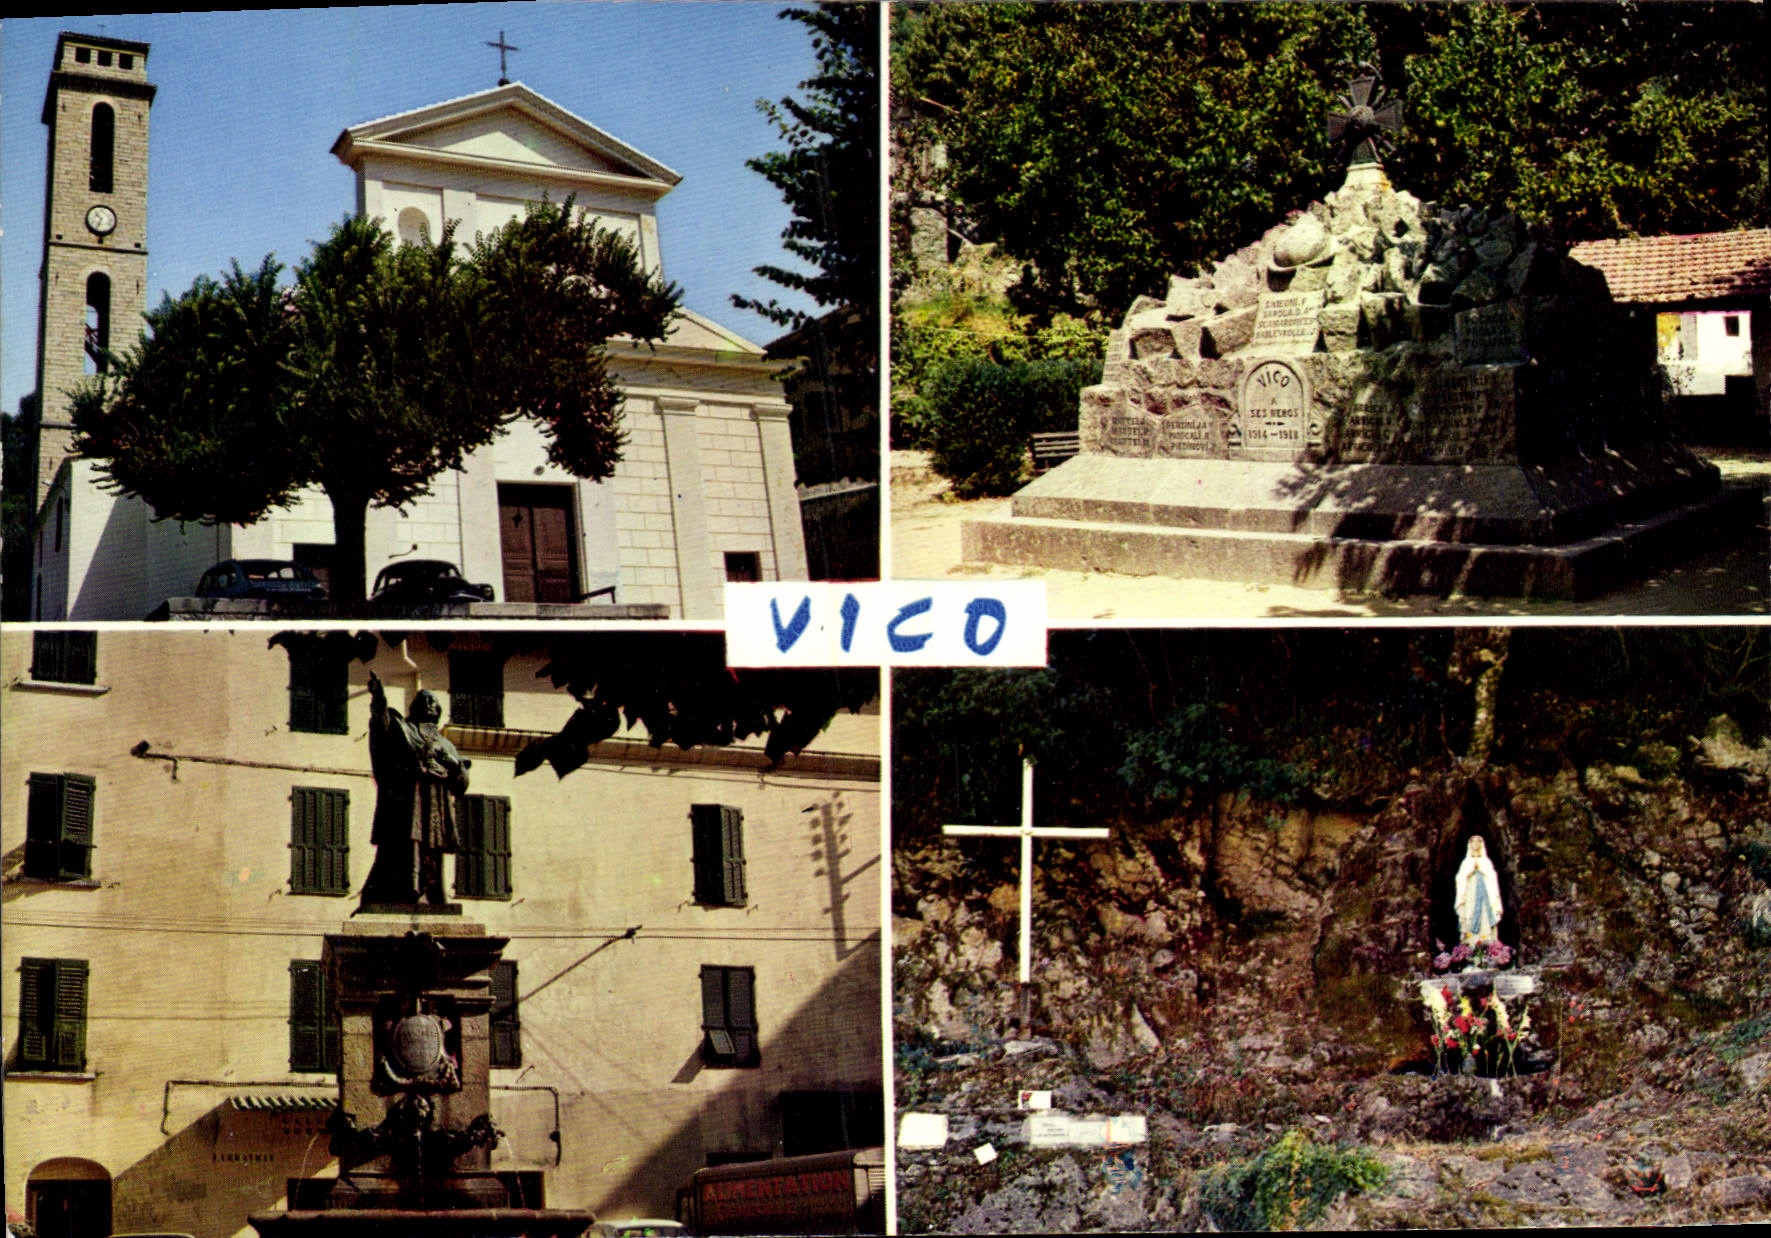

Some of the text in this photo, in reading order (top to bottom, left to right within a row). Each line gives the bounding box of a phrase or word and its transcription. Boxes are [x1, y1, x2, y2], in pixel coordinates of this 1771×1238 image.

[1256, 369, 1290, 388] VICO
[1250, 408, 1267, 418] SES
[703, 1169, 849, 1202] ALIMENTATION
